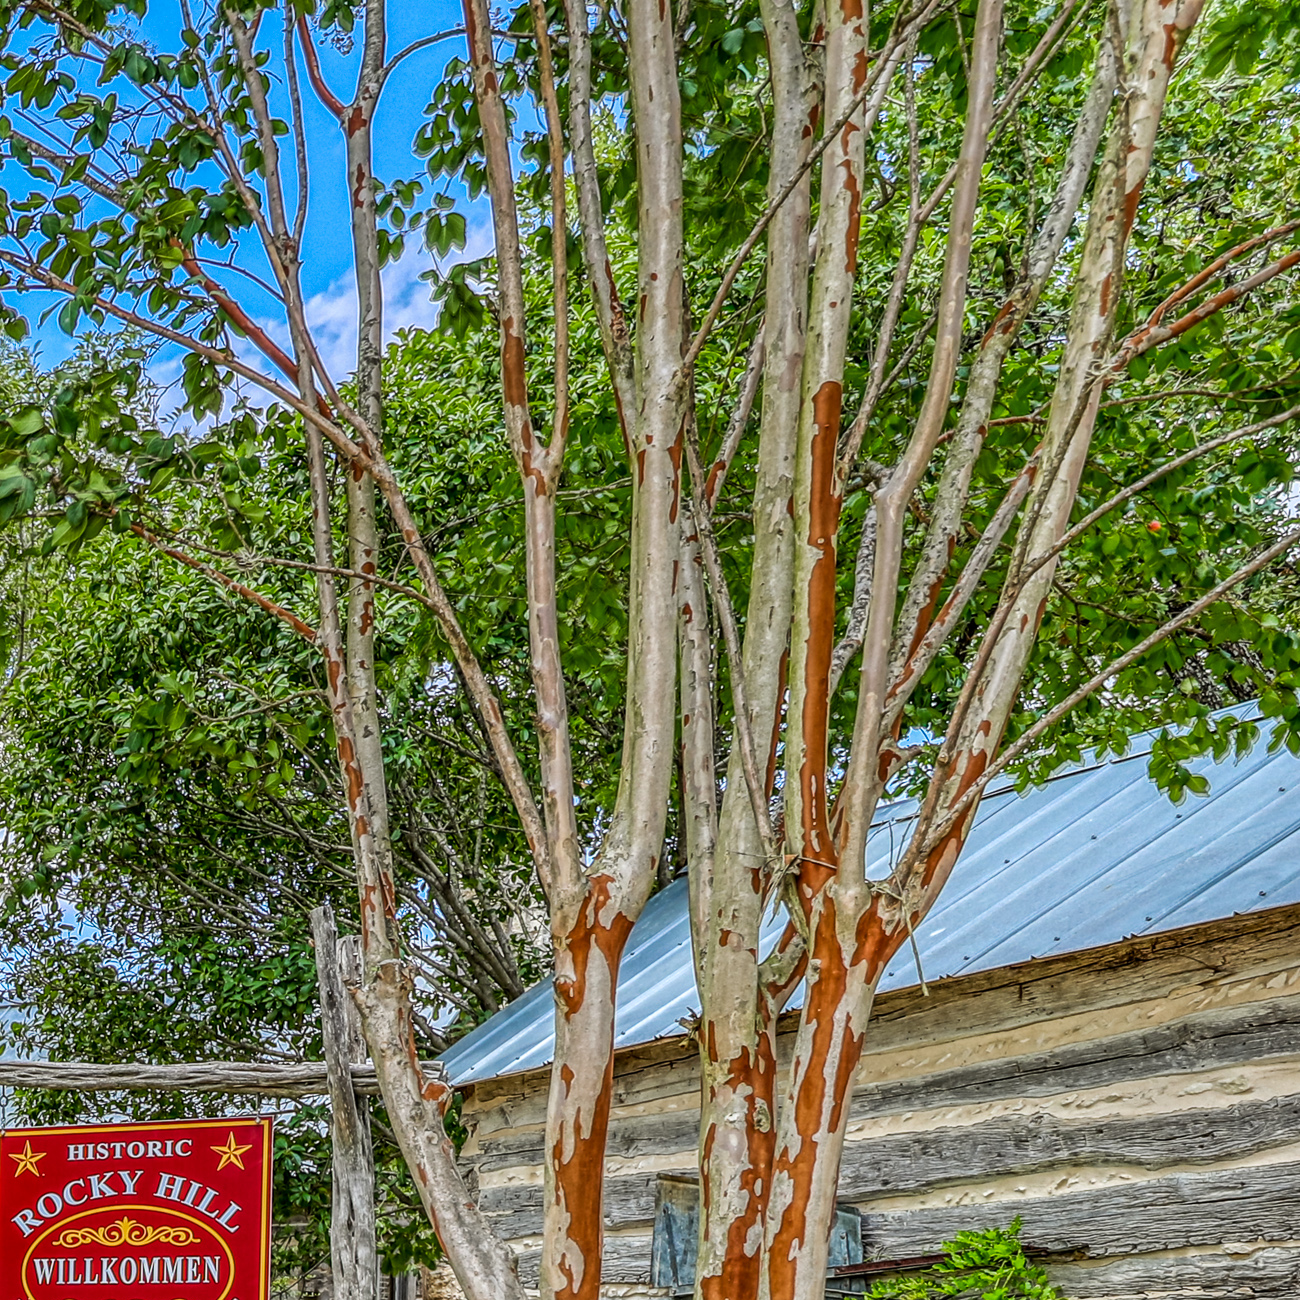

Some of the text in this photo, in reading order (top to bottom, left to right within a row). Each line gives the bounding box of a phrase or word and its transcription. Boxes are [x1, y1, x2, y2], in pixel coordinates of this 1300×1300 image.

[67, 1139, 193, 1161] HISTORIC
[11, 1170, 242, 1237] ROCKY HILL
[33, 1256, 221, 1285] WILLKOMMEN
